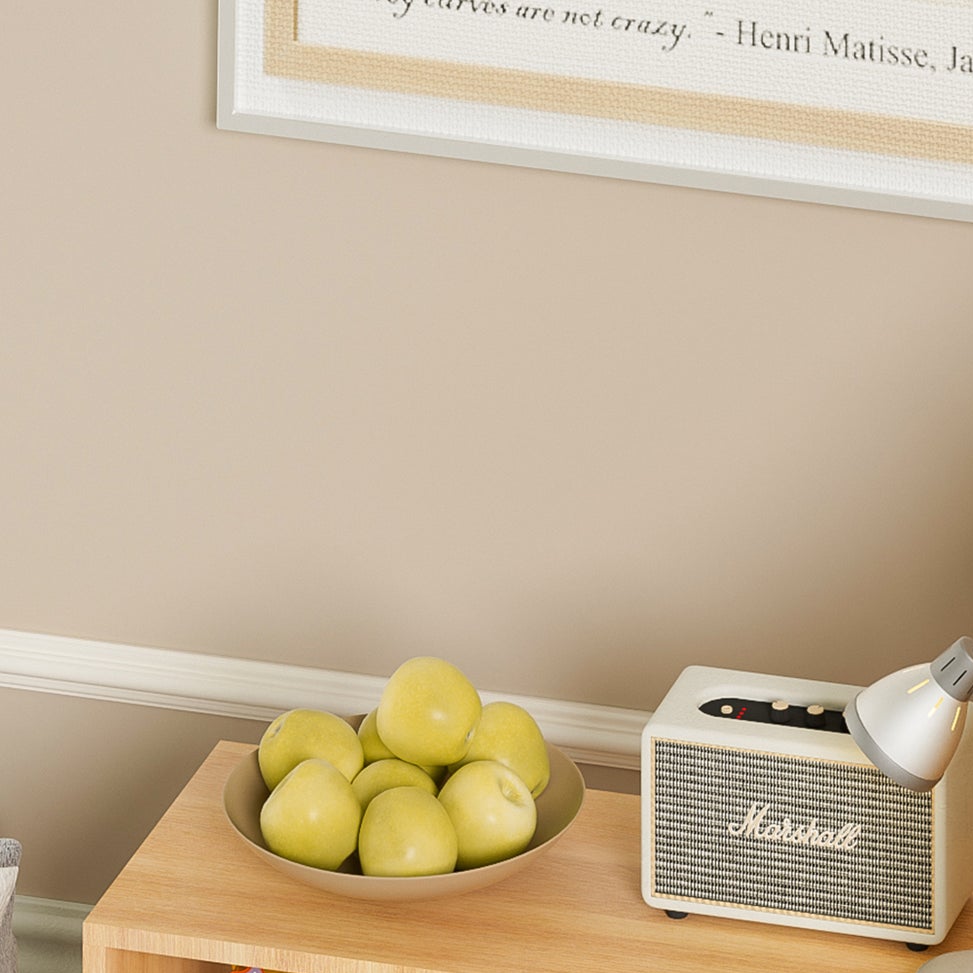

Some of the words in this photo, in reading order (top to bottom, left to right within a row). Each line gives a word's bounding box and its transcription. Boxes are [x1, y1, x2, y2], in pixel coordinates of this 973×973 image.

[515, 5, 555, 22] are
[562, 10, 602, 29] not
[736, 19, 811, 54] Henri
[823, 30, 936, 71] Matisse,
[728, 801, 861, 849] Marshall
